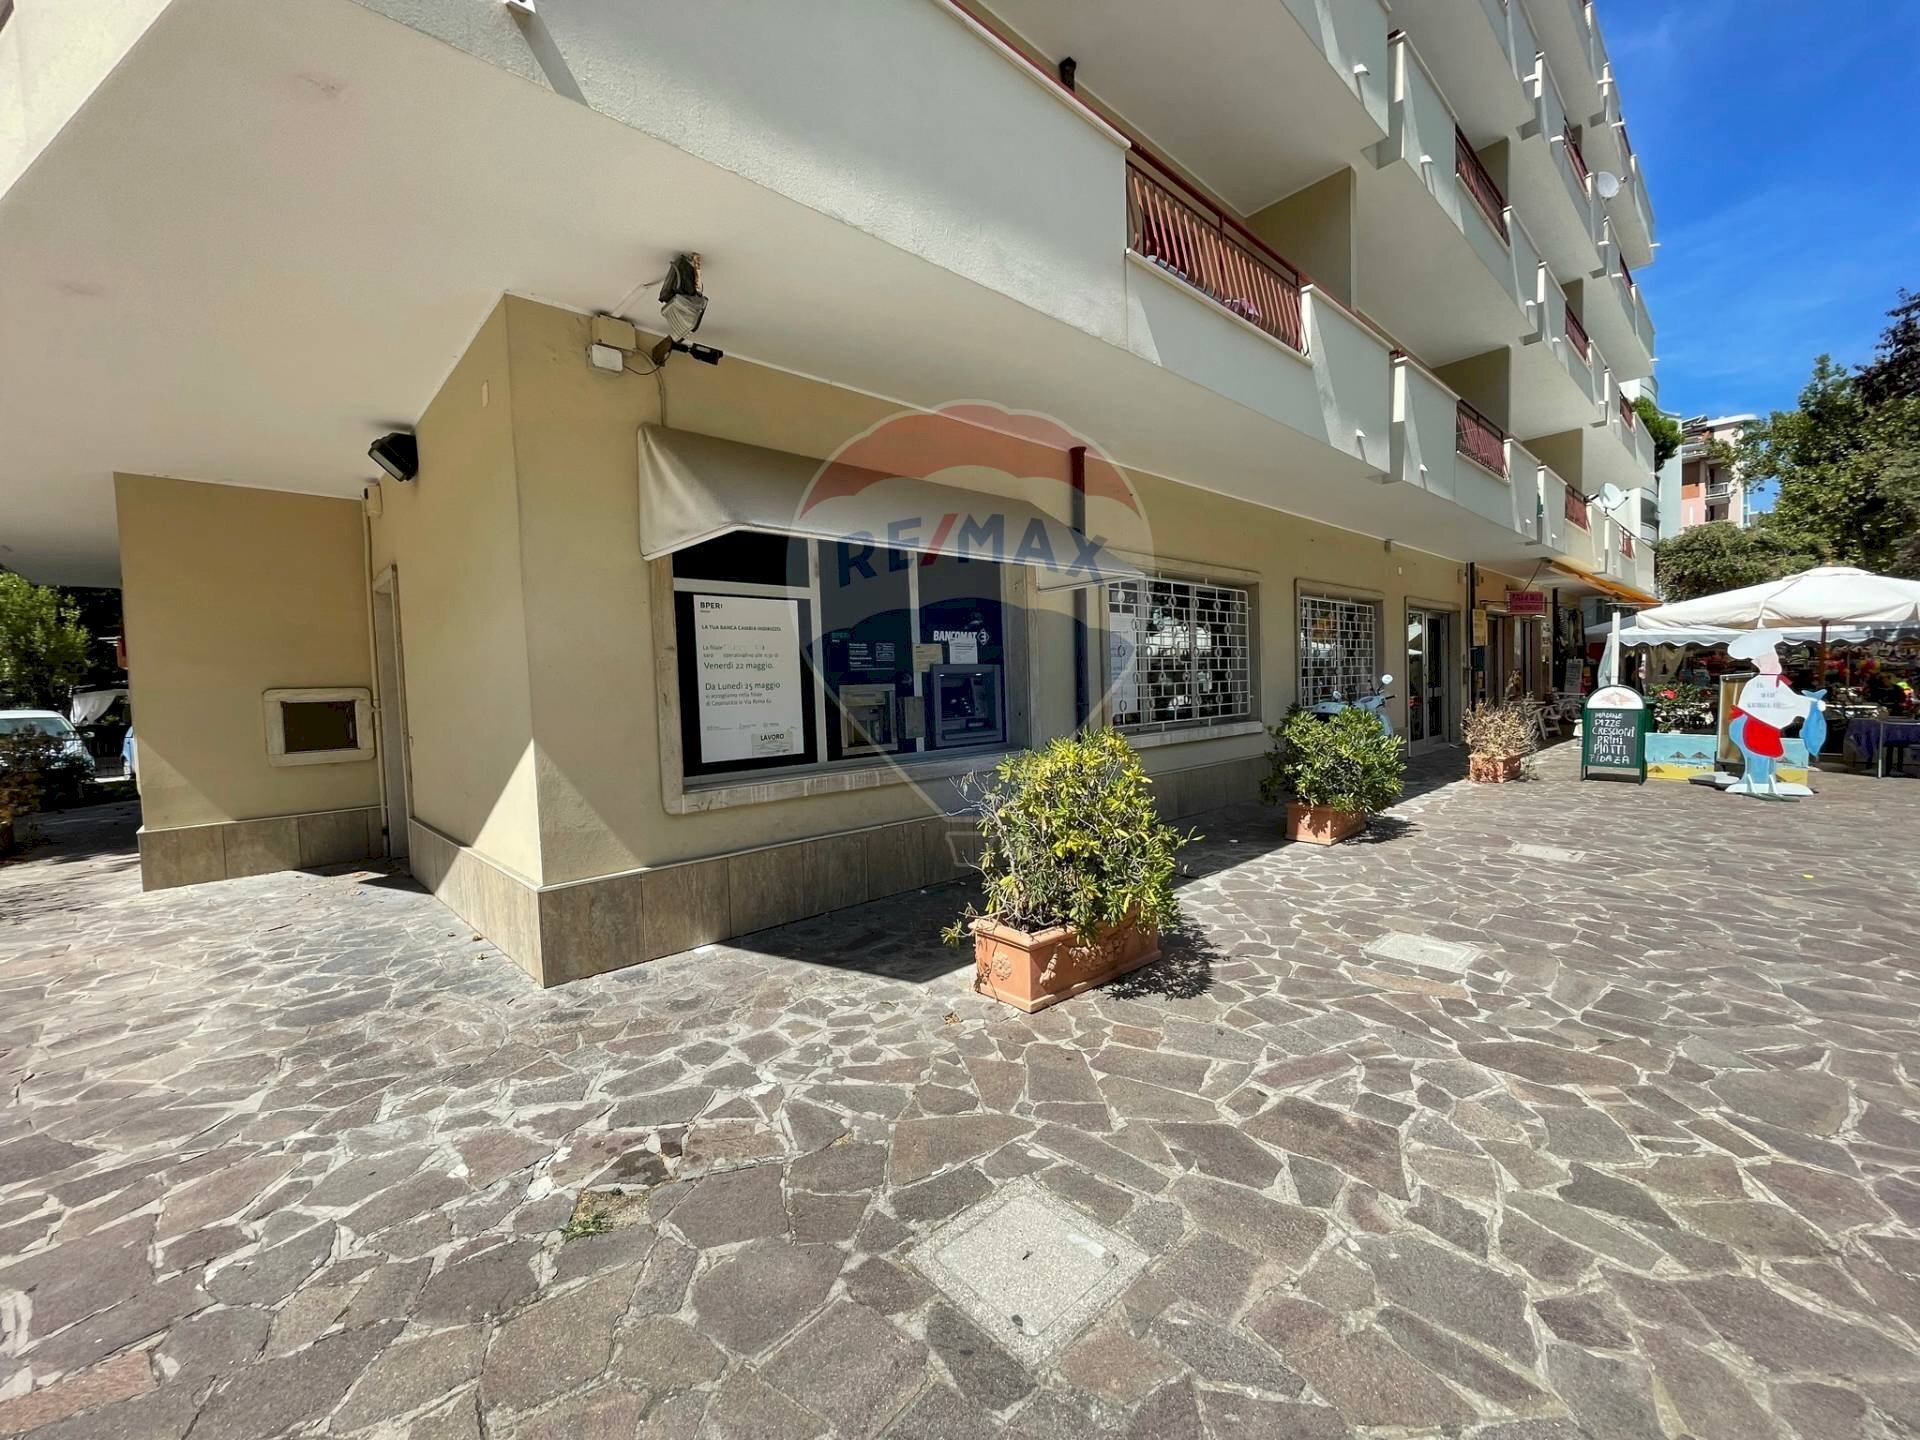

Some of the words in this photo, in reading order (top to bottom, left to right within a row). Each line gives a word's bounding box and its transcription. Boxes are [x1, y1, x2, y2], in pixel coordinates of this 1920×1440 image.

[933, 630, 978, 641] BANCOMAT
[705, 682, 716, 691] Da
[754, 681, 781, 691] maggio
[1594, 719, 1622, 727] PIZZE
[760, 733, 785, 741] LAVORO
[1597, 735, 1623, 745] PRIMI
